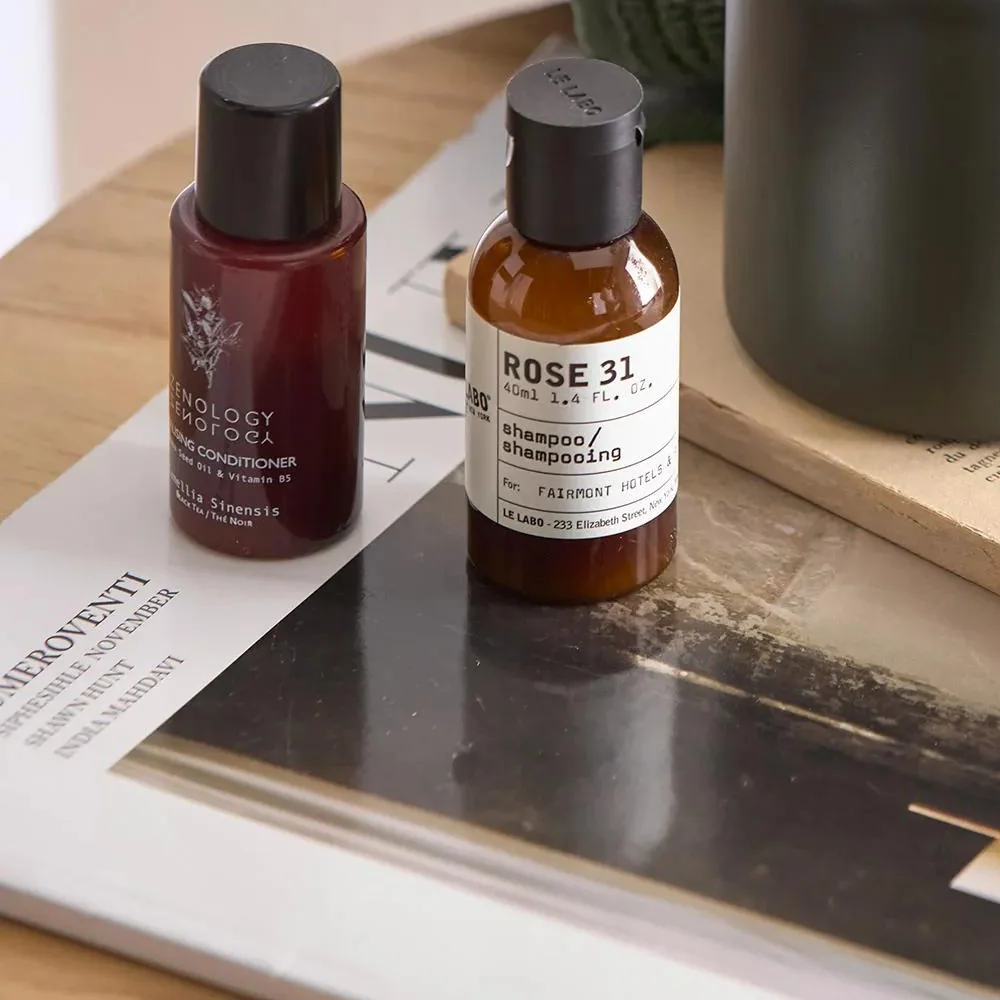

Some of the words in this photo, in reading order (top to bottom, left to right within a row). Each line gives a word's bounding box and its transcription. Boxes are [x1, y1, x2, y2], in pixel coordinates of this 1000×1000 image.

[504, 351, 589, 388] ROSE
[600, 355, 634, 386] 31
[503, 382, 539, 402] 40ml
[551, 392, 580, 406] 1.4
[592, 391, 619, 403] FL.
[631, 378, 653, 395] OZ.
[502, 422, 602, 449] shampoo/
[197, 445, 297, 470] CONDITIONER
[502, 441, 622, 466] shampooing
[943, 447, 966, 463] du
[197, 462, 212, 475] Oil
[216, 469, 225, 479] &
[228, 472, 273, 484] Vitamin
[279, 474, 292, 483] B5
[503, 477, 521, 492] For:
[538, 485, 612, 500] FAIRMONT
[621, 464, 663, 492] HOTELS
[210, 497, 280, 517] Sinensis
[503, 508, 515, 520] LE
[517, 512, 545, 527] LABO
[553, 519, 573, 530] 233
[576, 516, 619, 530] Elizabeth
[84, 588, 180, 661] NOVEMBER
[0, 571, 150, 707] MEROVENTI
[24, 698, 88, 748] SHAWN
[81, 659, 136, 700] HUNT
[54, 717, 110, 759] INDIA
[101, 655, 185, 720] MAHDAVI
